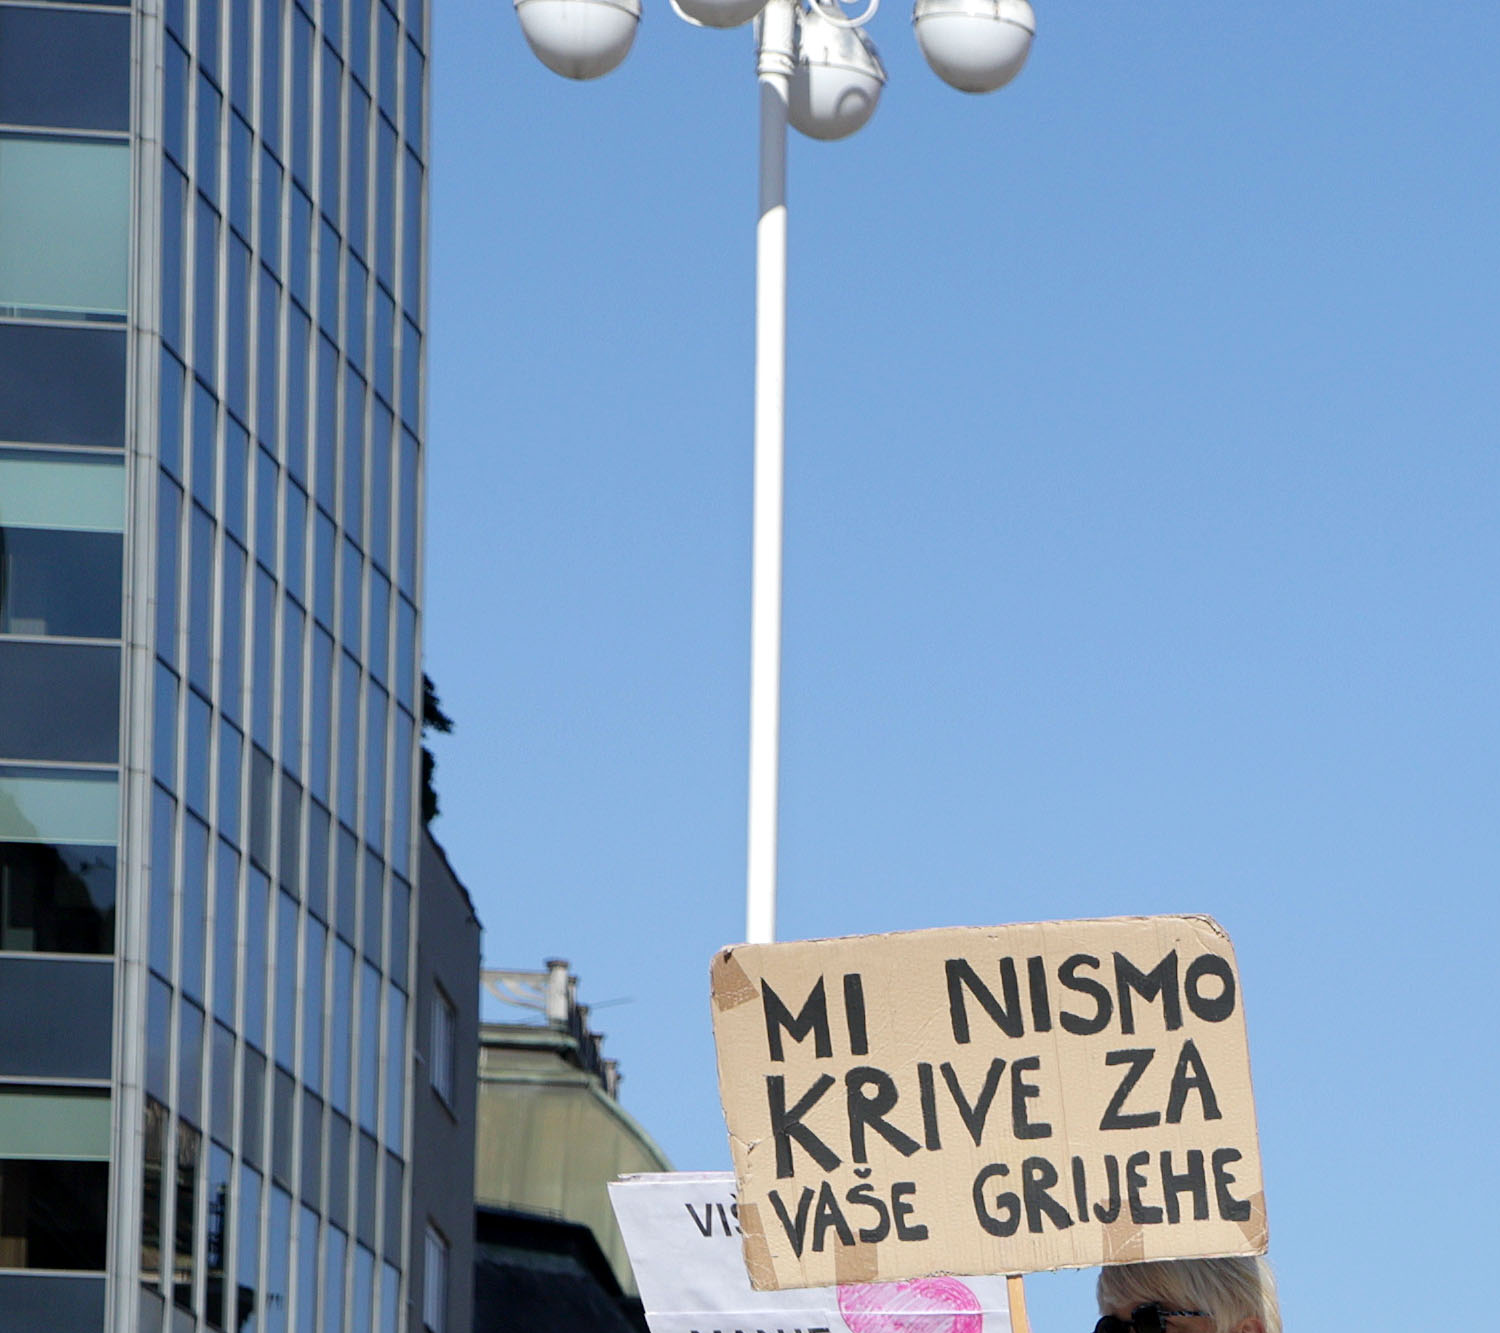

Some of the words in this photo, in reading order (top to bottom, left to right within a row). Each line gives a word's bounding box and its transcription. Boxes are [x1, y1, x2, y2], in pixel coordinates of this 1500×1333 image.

[760, 972, 870, 1062] MI
[944, 949, 1237, 1045] NISMO
[766, 1055, 1053, 1179] KRIVE
[1099, 1038, 1222, 1132] ZA
[768, 1167, 930, 1262] VAŠE
[973, 1147, 1253, 1238] GRIJEHE
